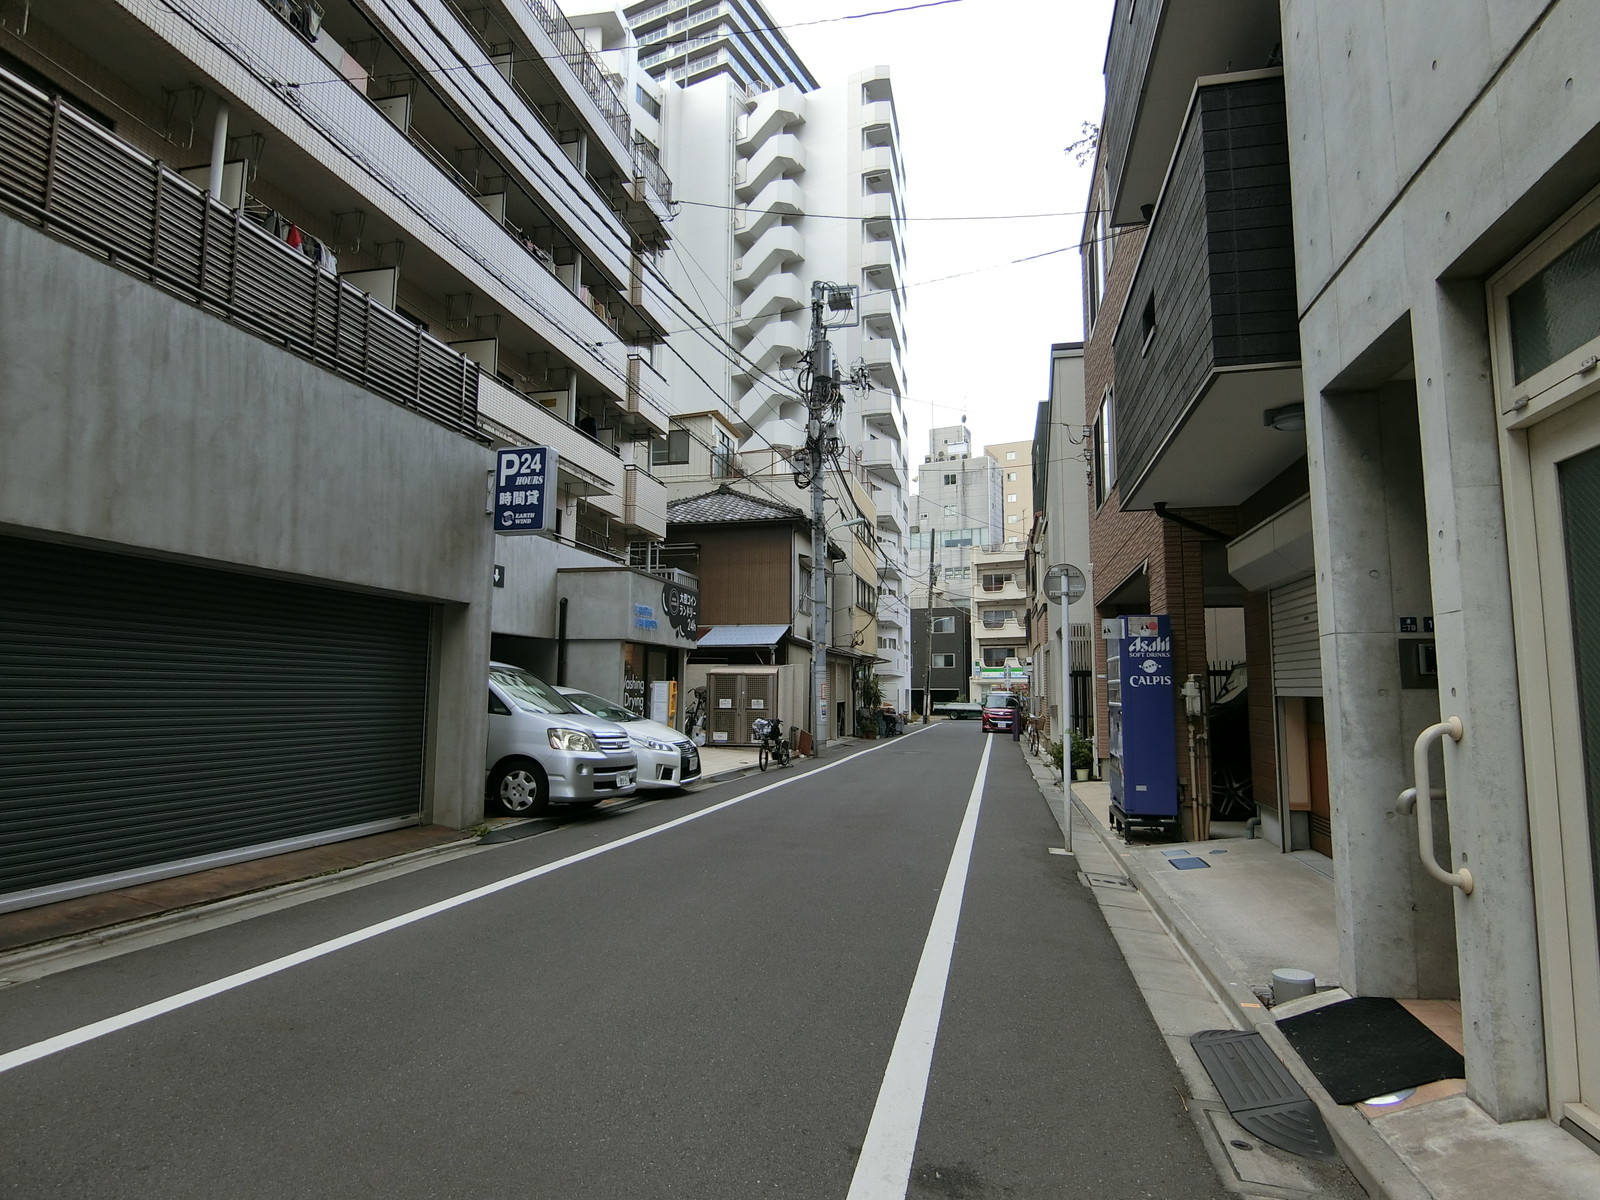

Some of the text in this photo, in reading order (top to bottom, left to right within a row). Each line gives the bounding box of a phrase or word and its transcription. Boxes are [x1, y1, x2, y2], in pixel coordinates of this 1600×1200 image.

[500, 453, 541, 486] P 24
[515, 476, 544, 485] HOURS
[499, 490, 540, 506] 時間貸
[1129, 636, 1170, 651] Asahi
[1129, 675, 1171, 687] CALPIS
[624, 692, 645, 711] Drying
